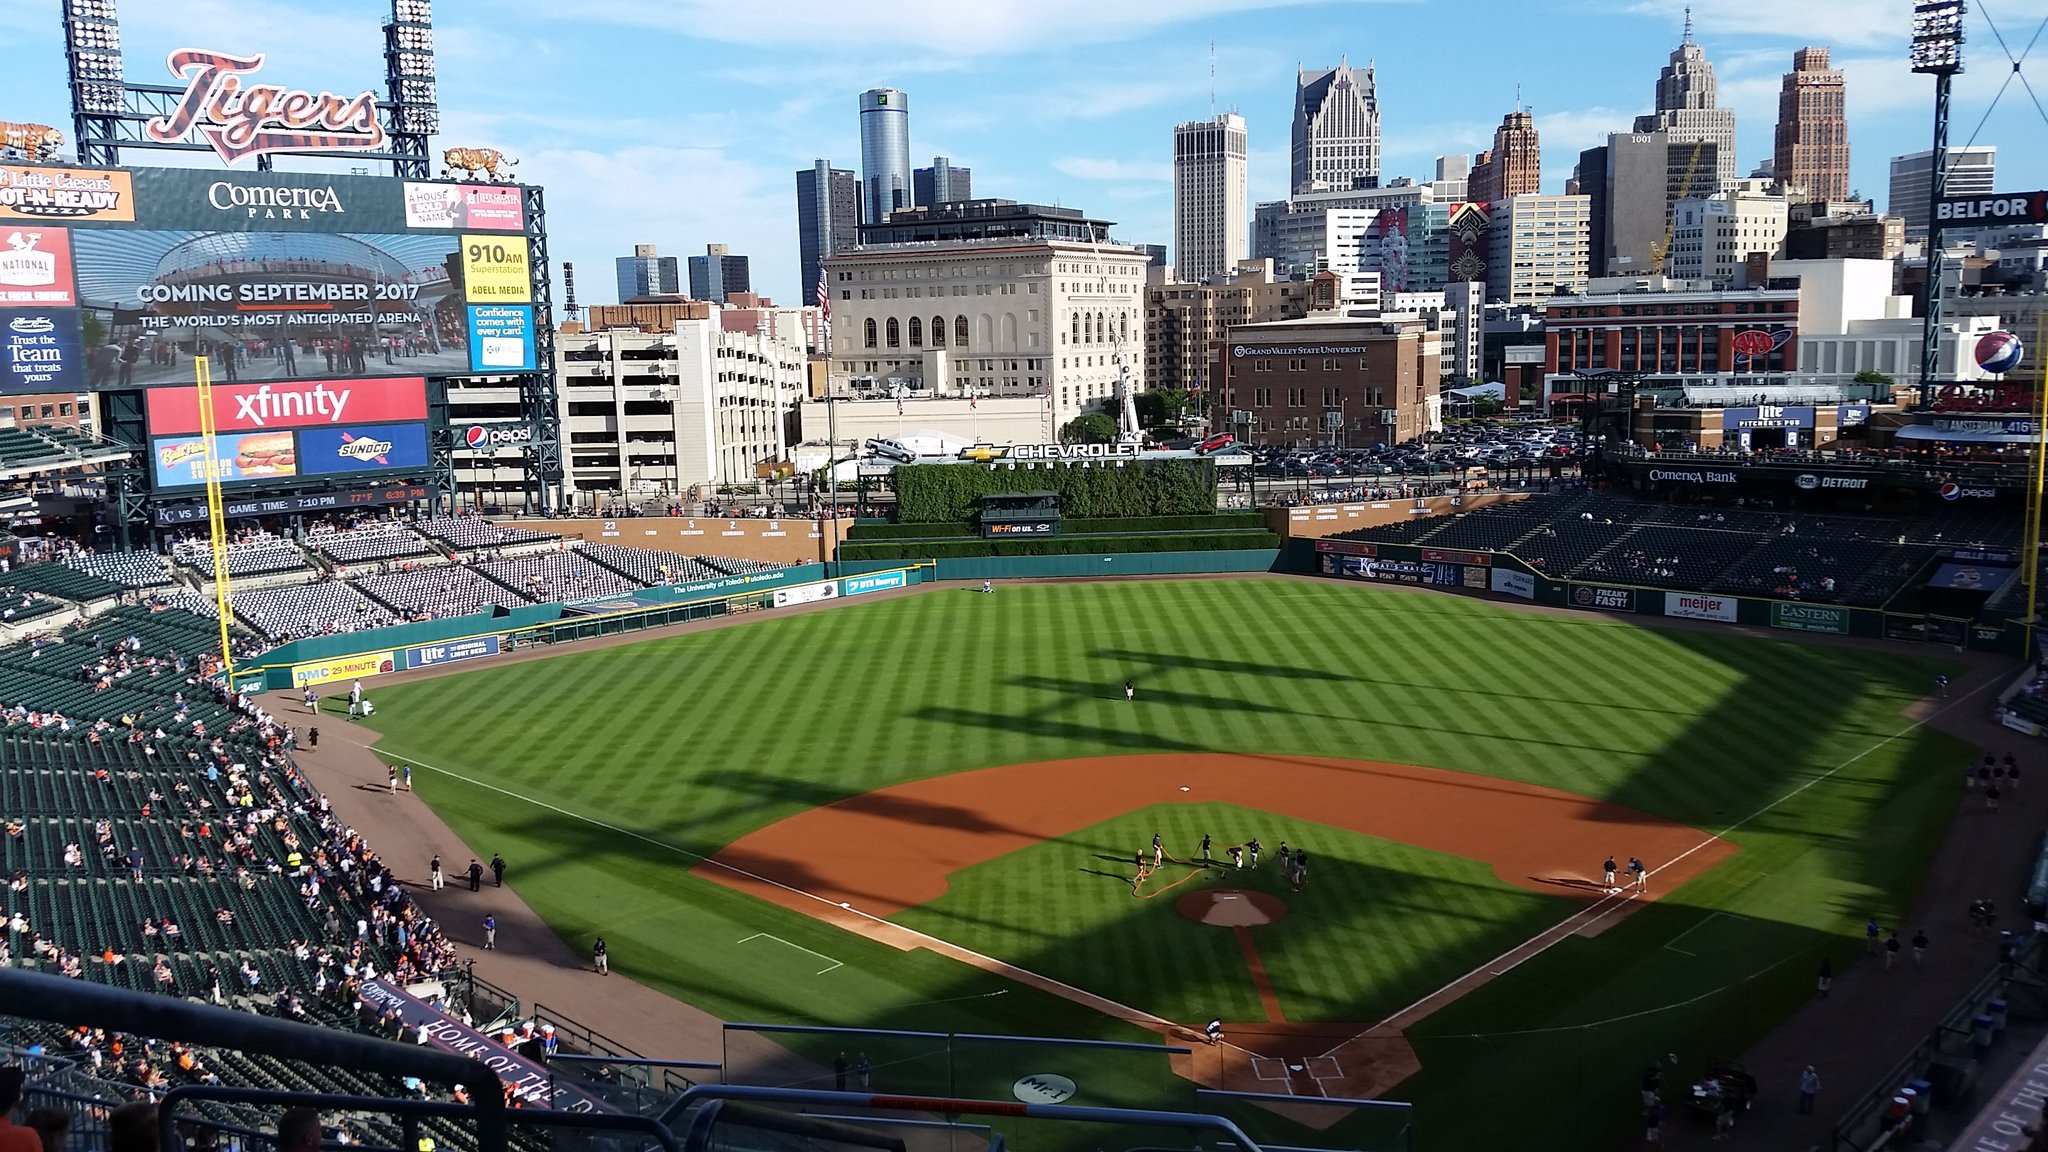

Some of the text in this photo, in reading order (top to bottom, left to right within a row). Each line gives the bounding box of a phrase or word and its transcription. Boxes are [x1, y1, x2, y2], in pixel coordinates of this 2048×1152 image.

[146, 48, 385, 167] Tigers
[1631, 136, 1651, 144] 1001
[11, 171, 111, 191] Little Caesars
[416, 191, 448, 201] HOUSE
[20, 206, 90, 215] PIZZA
[415, 202, 443, 212] SOLD
[1937, 198, 2028, 220] BELFOR
[248, 208, 311, 220] PARK
[418, 214, 446, 223] NAME
[3, 260, 48, 271] NATIONAL
[471, 264, 524, 275] Superstation
[136, 283, 420, 303] COMING SEPTEMBER 2017
[472, 286, 525, 295] ADELL MEDIA
[475, 307, 524, 317] Confidence
[139, 312, 422, 328] THE WORLD'S MOST ANTICIPATED ARENA
[506, 316, 525, 326] with
[476, 328, 501, 337] every
[11, 335, 56, 345] Trust the
[7, 344, 63, 362] Team
[12, 363, 62, 373] that treats
[24, 374, 52, 384] yours
[234, 384, 350, 425] xfinity
[1759, 405, 1784, 420] Lite
[490, 426, 532, 445] pepsi
[341, 443, 390, 455] SUNOCO
[1015, 443, 1144, 459] CHEVROLET
[220, 458, 232, 467] ON
[990, 460, 1124, 471] FOUNTAIN
[1706, 471, 1738, 483] Bank
[1822, 477, 1869, 489] DETROIT
[1961, 488, 1996, 498] pepsi
[178, 510, 192, 518] VS
[228, 503, 258, 514] GAME
[261, 501, 288, 512] TIME:
[297, 497, 319, 508] 7:10
[320, 496, 335, 506] PM
[350, 493, 373, 503] 77°F
[386, 490, 405, 500] 6:39
[410, 488, 426, 498] PM
[1416, 497, 1461, 508] 11 42
[604, 520, 818, 531] 23 5 2 16 6
[991, 524, 1033, 533] Wi-Fi on us.
[673, 586, 687, 594] The
[686, 581, 717, 594] University
[725, 577, 745, 587] Toledo
[750, 571, 784, 584] utoledo.edu
[563, 591, 633, 607] MotorCityCasino.com
[1597, 589, 1628, 598] FREAKY
[1595, 597, 1627, 607] FAST!
[1679, 596, 1723, 612] meijer
[1781, 603, 1840, 621] EASTERN
[420, 645, 446, 665] Lite
[297, 667, 330, 682] DMC
[332, 664, 342, 675] 29
[344, 660, 377, 674] MINUTE
[426, 1019, 489, 1058] HOME
[484, 1055, 522, 1075] OF
[519, 1071, 568, 1101] THE
[1021, 1077, 1068, 1100] Mr. I
[1991, 1110, 2027, 1136] OF
[2010, 1079, 2048, 1110] THE
